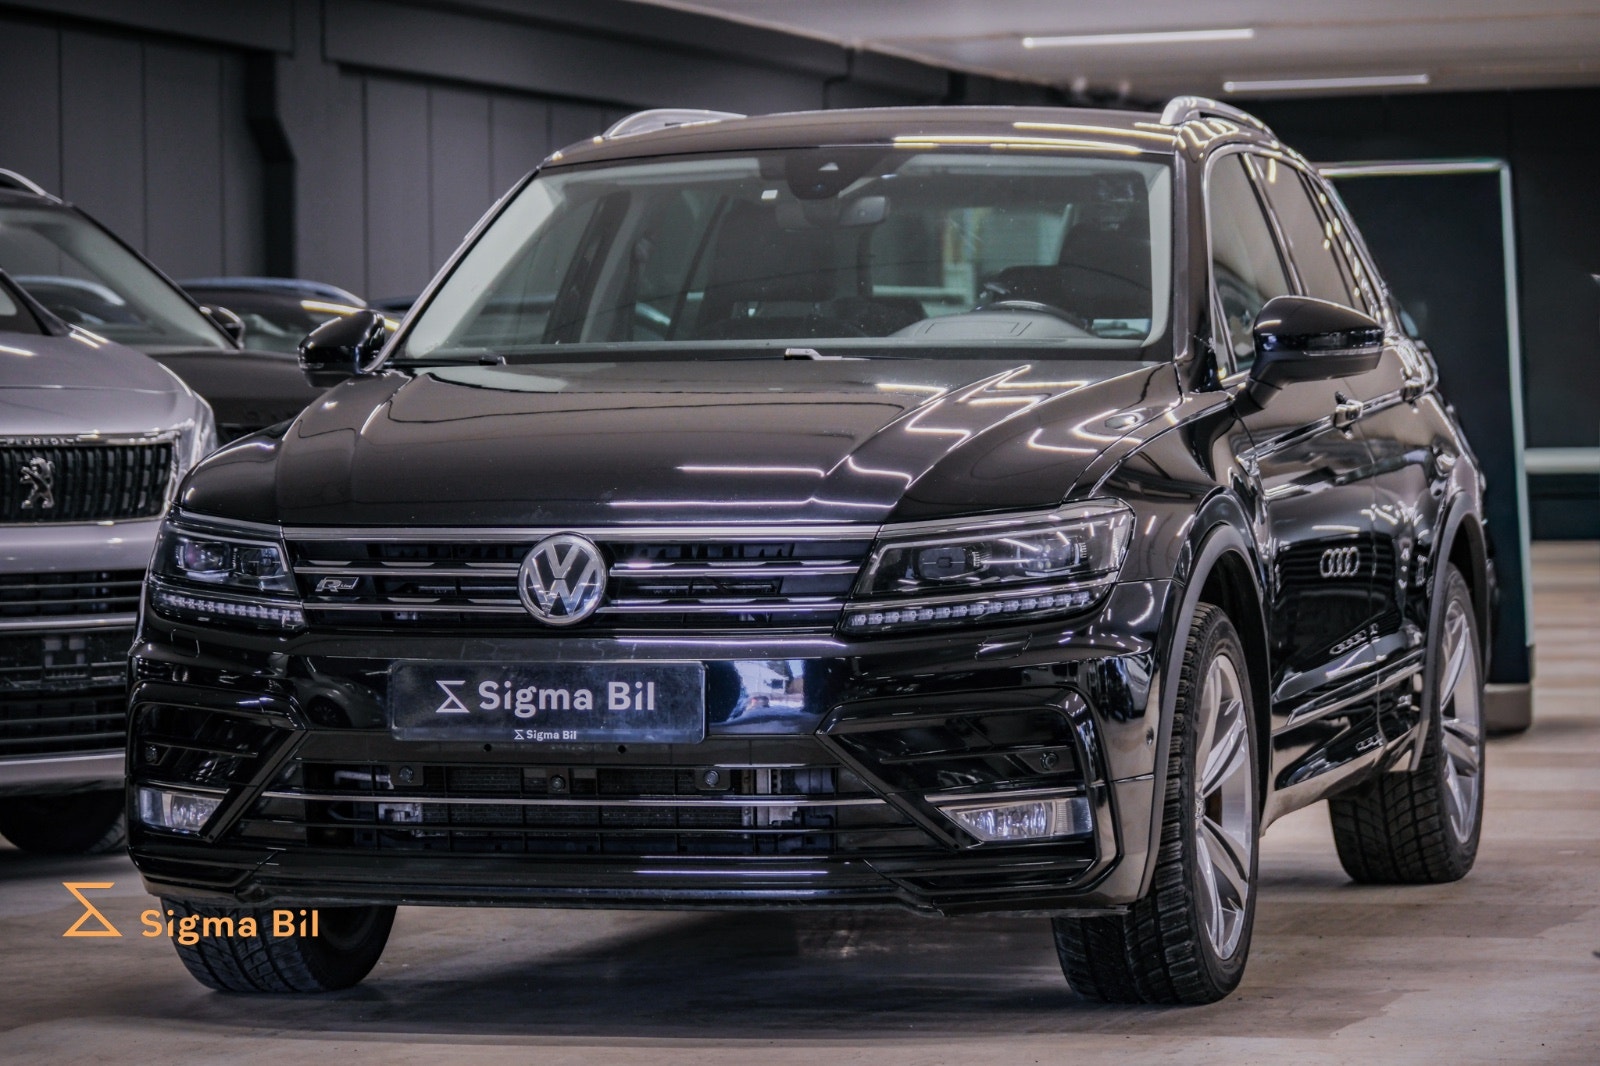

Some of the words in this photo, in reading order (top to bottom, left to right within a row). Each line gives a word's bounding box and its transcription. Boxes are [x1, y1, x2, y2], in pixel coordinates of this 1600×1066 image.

[524, 540, 600, 619] VW
[478, 680, 593, 718] Sigma
[608, 681, 655, 710] Bil
[526, 729, 560, 742] Sigma
[562, 730, 577, 740] Bil
